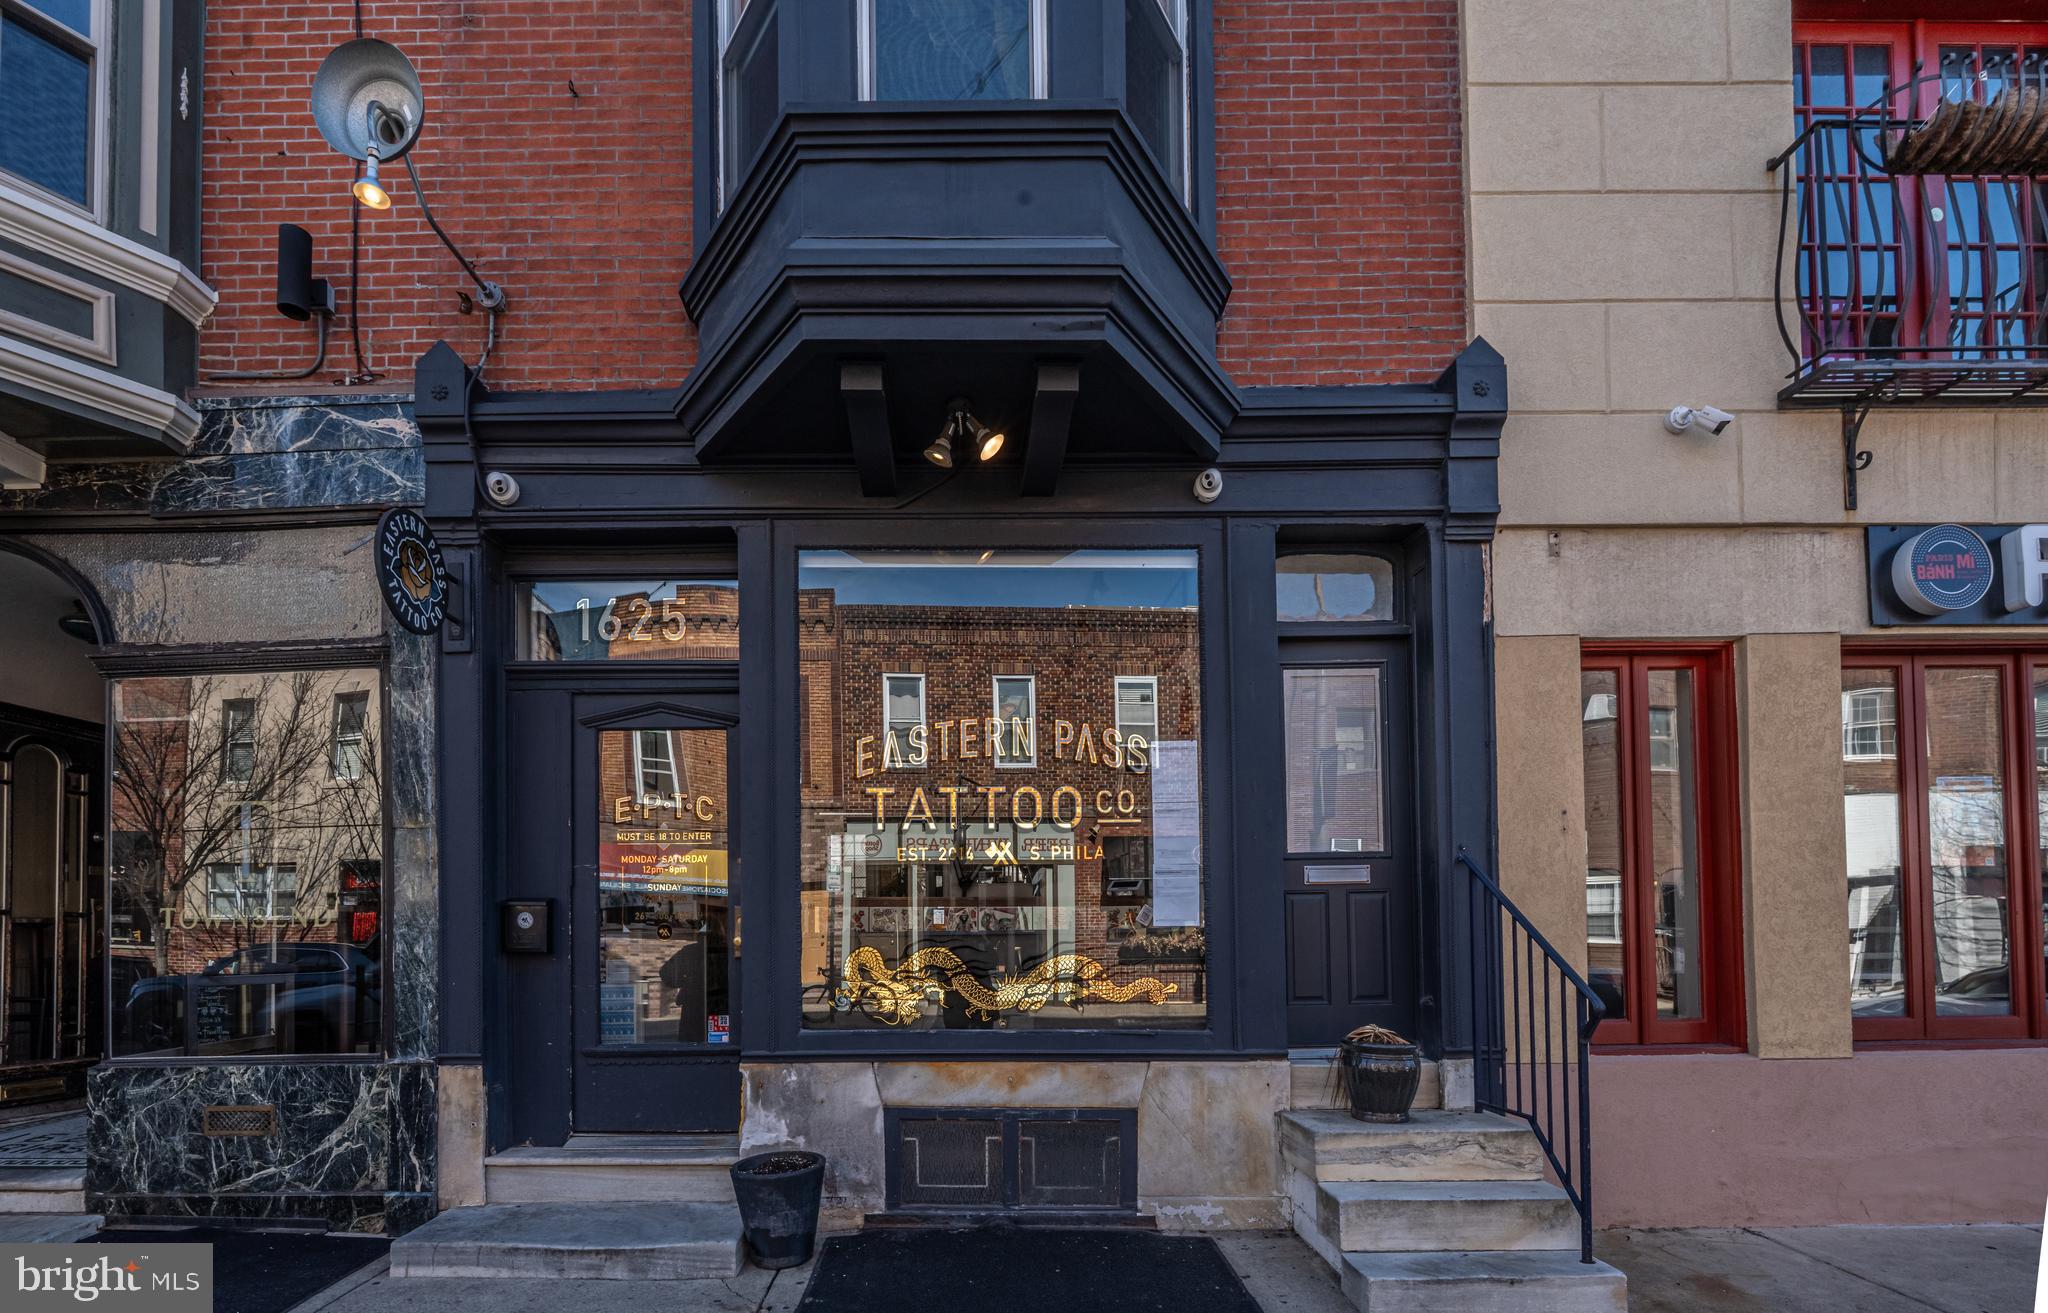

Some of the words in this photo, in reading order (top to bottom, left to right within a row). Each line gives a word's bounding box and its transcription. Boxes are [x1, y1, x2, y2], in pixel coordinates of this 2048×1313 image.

[383, 514, 425, 557] EASTERN
[428, 538, 448, 590] PASS
[388, 578, 428, 631] TATTOO
[430, 606, 443, 627] CO
[576, 598, 687, 641] 1625
[856, 717, 1034, 778] EASTERN
[1054, 719, 1148, 774] PASS
[865, 785, 1083, 831] TATTOO
[1096, 788, 1142, 815] CO.
[616, 832, 641, 841] MUST
[644, 832, 655, 841] BE
[659, 832, 668, 841] 18
[670, 832, 681, 841] TO
[682, 832, 712, 841] ENTER
[897, 846, 932, 862] EST.
[1030, 846, 1042, 861] S.
[1051, 846, 1105, 861] PHILA
[647, 883, 682, 892] SUNDAY
[159, 907, 332, 931] TOWNSEND
